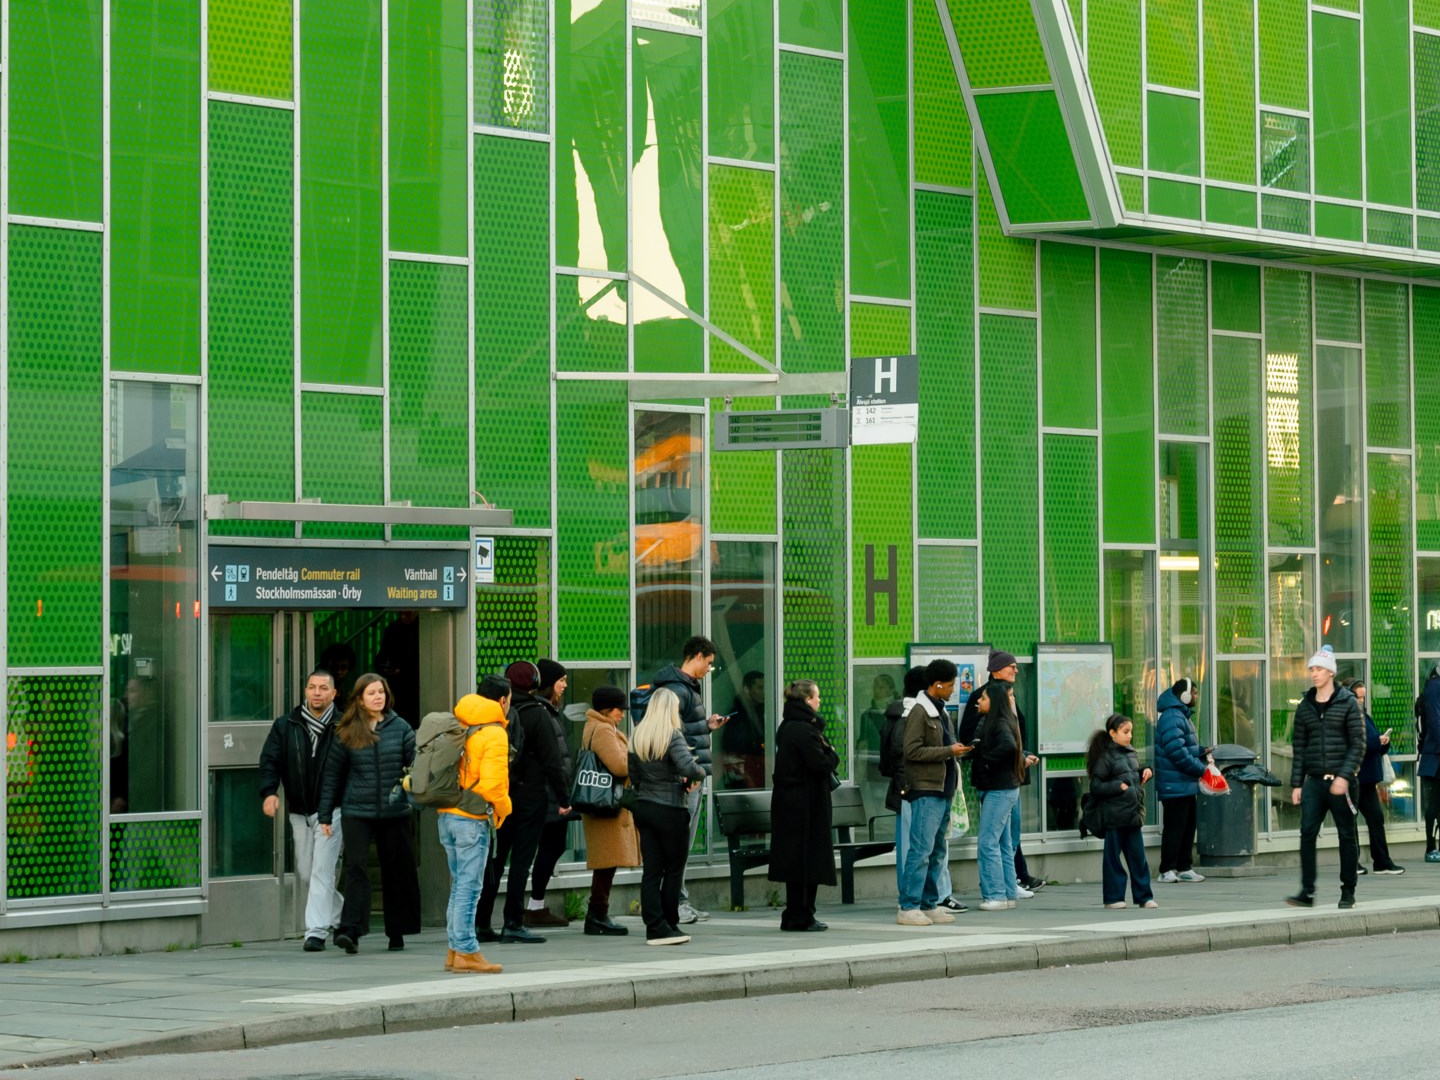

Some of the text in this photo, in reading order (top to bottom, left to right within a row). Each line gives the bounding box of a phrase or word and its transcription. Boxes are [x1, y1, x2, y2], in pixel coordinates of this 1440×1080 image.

[875, 357, 897, 393] H
[256, 567, 360, 582] Pendeltåg Commuter rail
[405, 568, 437, 581] Vänthall
[255, 583, 362, 602] Stockholmsmässan Örby
[865, 544, 897, 625] H
[387, 586, 437, 601] Waiting area
